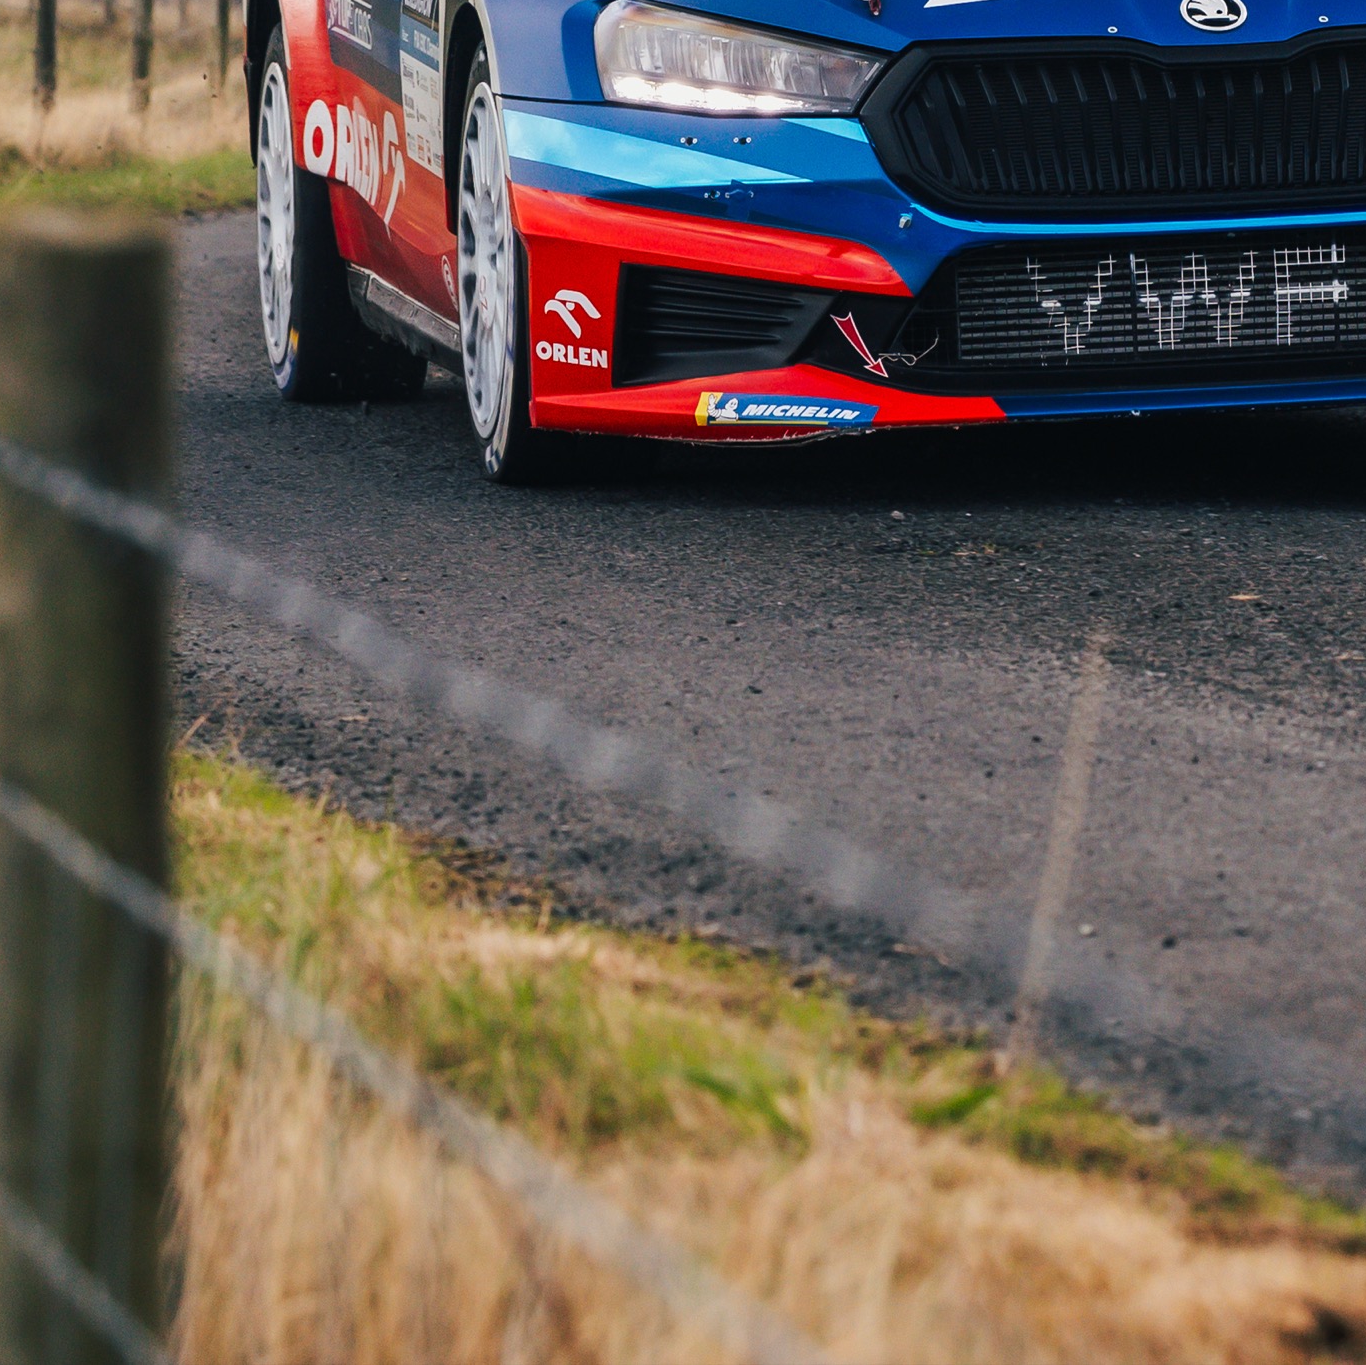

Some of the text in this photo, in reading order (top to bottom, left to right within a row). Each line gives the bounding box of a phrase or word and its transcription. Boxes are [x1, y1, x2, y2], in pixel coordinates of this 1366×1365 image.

[303, 99, 380, 207] ORLEN
[536, 340, 609, 369] ORLEN
[741, 404, 861, 421] MICHELIN
